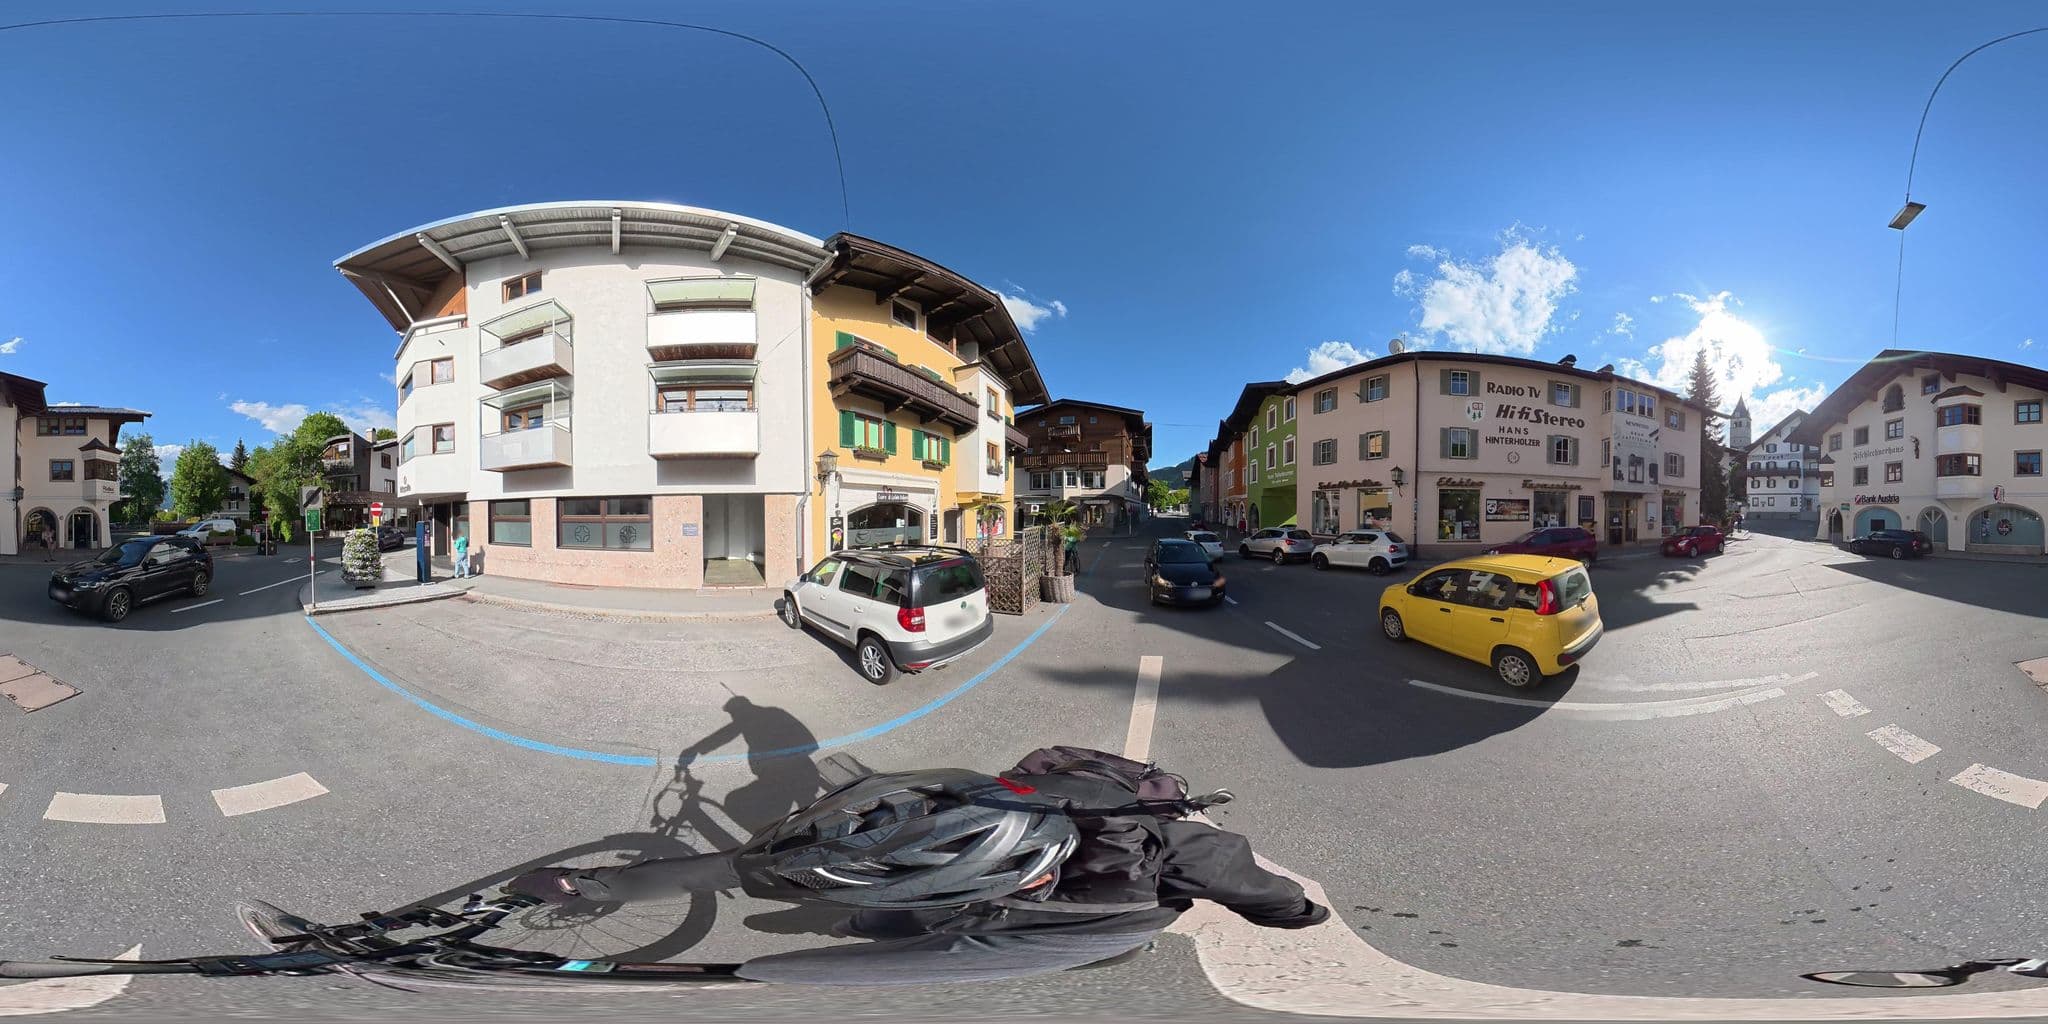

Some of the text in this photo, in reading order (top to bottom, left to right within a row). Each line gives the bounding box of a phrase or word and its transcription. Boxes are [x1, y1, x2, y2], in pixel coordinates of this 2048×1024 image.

[1487, 382, 1541, 398] RADIO TV
[1529, 408, 1585, 428] Stereo
[1499, 426, 1529, 435] HANS
[1485, 436, 1540, 447] HINTERHOLZER
[1862, 493, 1900, 503] Bank Austria
